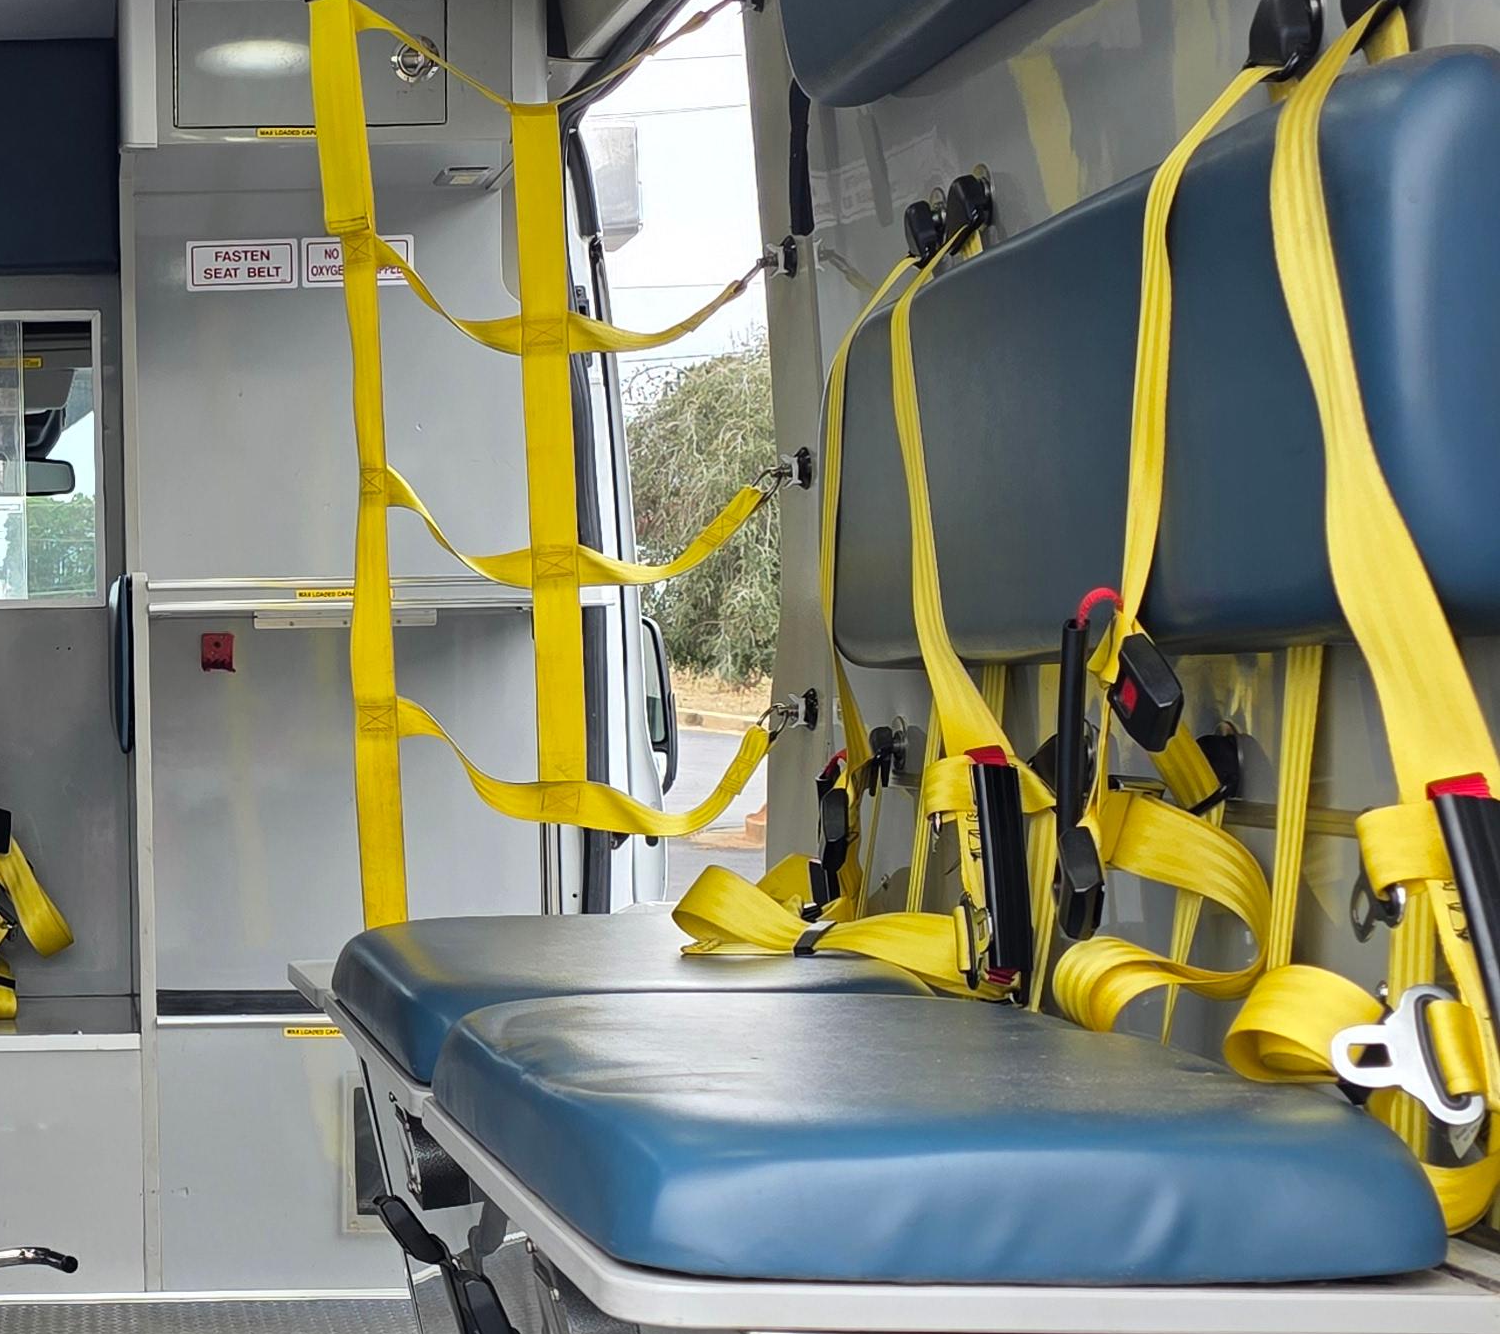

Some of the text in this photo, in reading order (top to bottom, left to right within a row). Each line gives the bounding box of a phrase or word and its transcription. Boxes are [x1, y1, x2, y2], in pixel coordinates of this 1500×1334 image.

[214, 250, 271, 263] FASTEN
[324, 248, 340, 260] NO
[203, 266, 282, 280] SEAT BELT
[311, 265, 345, 277] OXYGE
